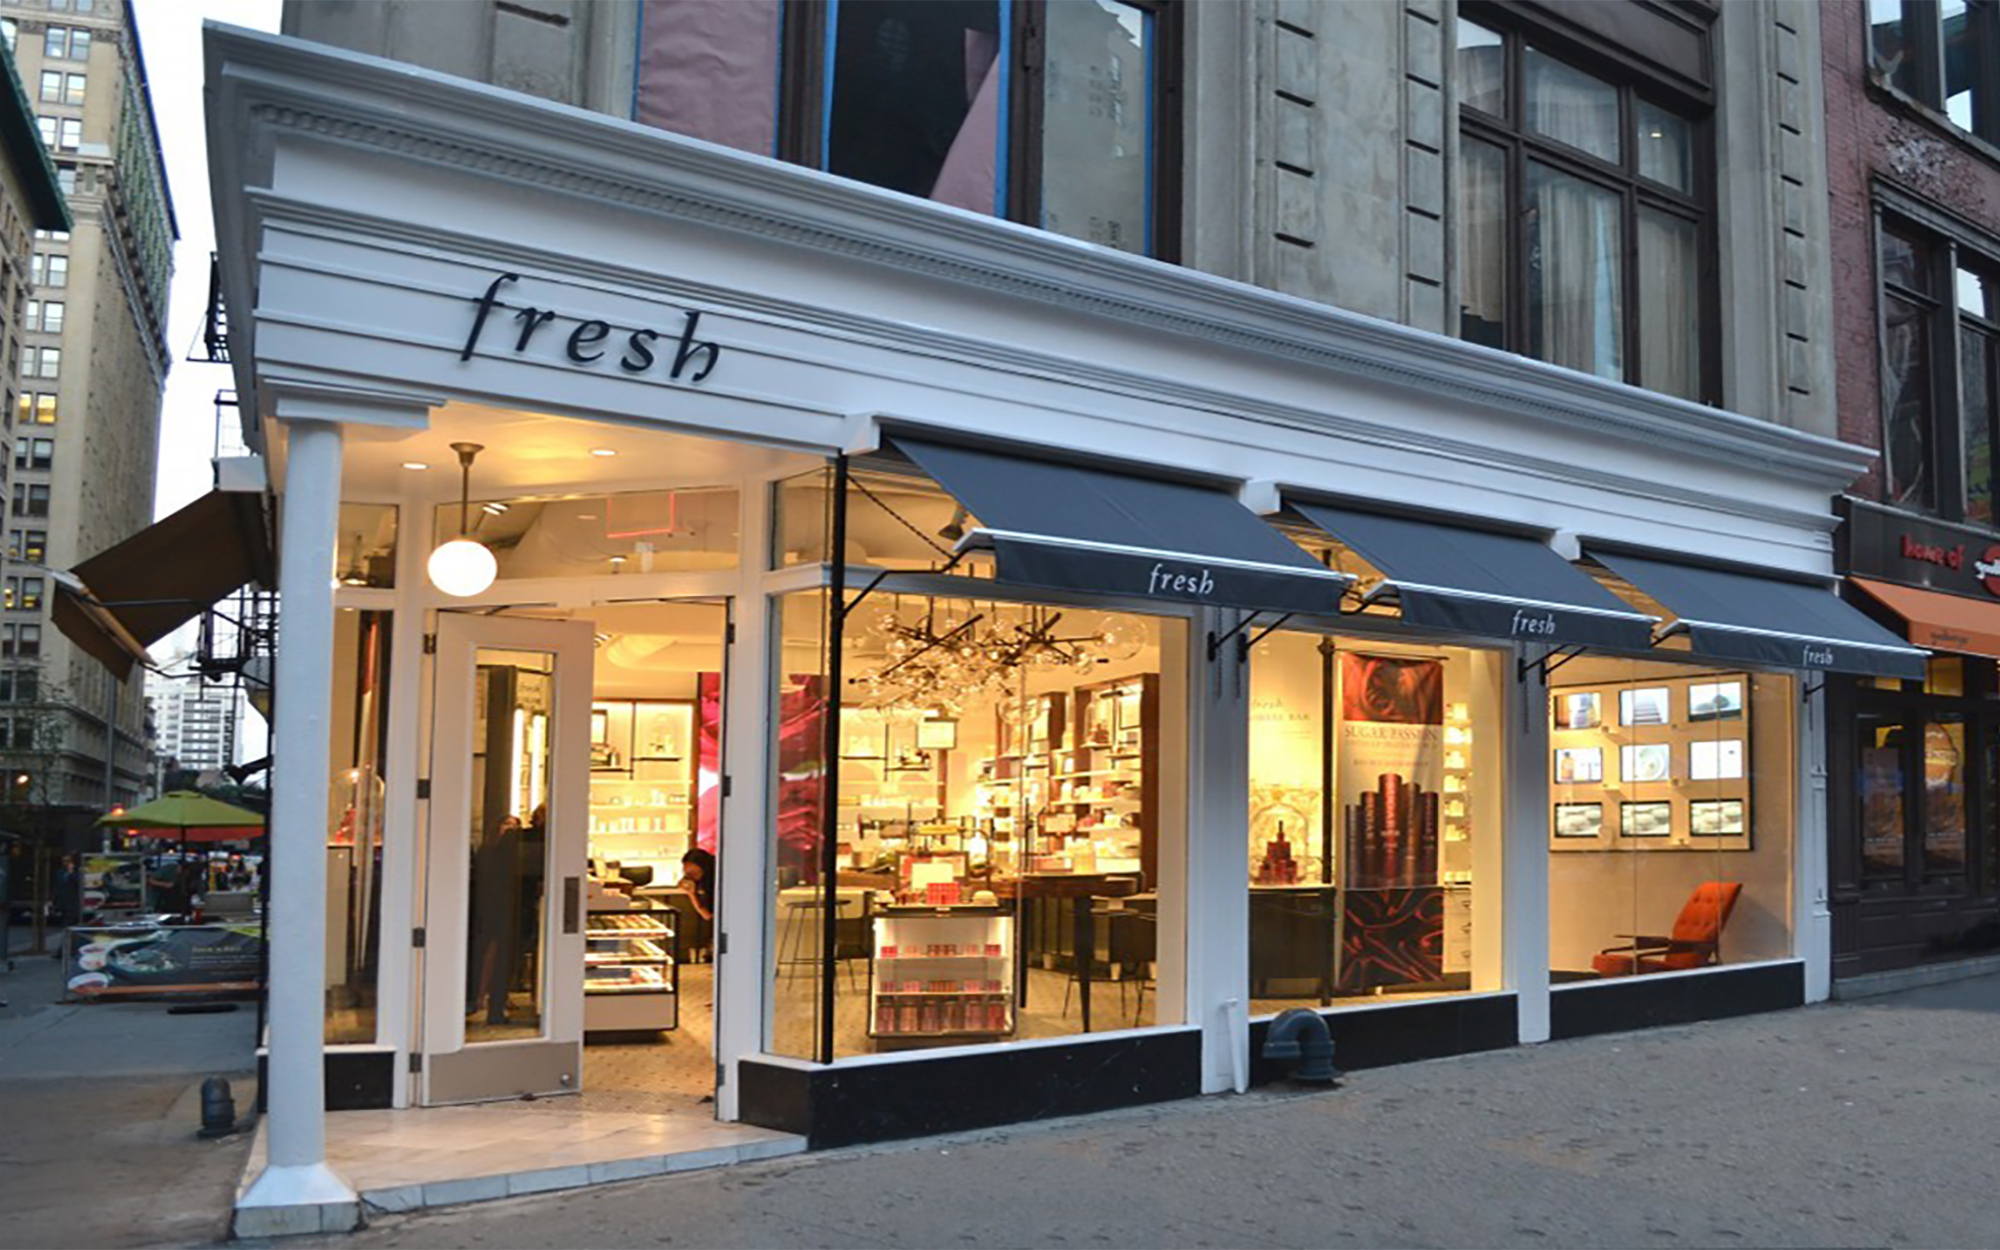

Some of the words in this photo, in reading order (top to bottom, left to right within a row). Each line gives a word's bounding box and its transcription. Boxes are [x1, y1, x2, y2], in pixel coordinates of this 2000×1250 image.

[460, 272, 721, 382] fresh
[1148, 563, 1214, 595] fresh
[1511, 609, 1556, 635] fresh
[1803, 644, 1833, 667] fresh
